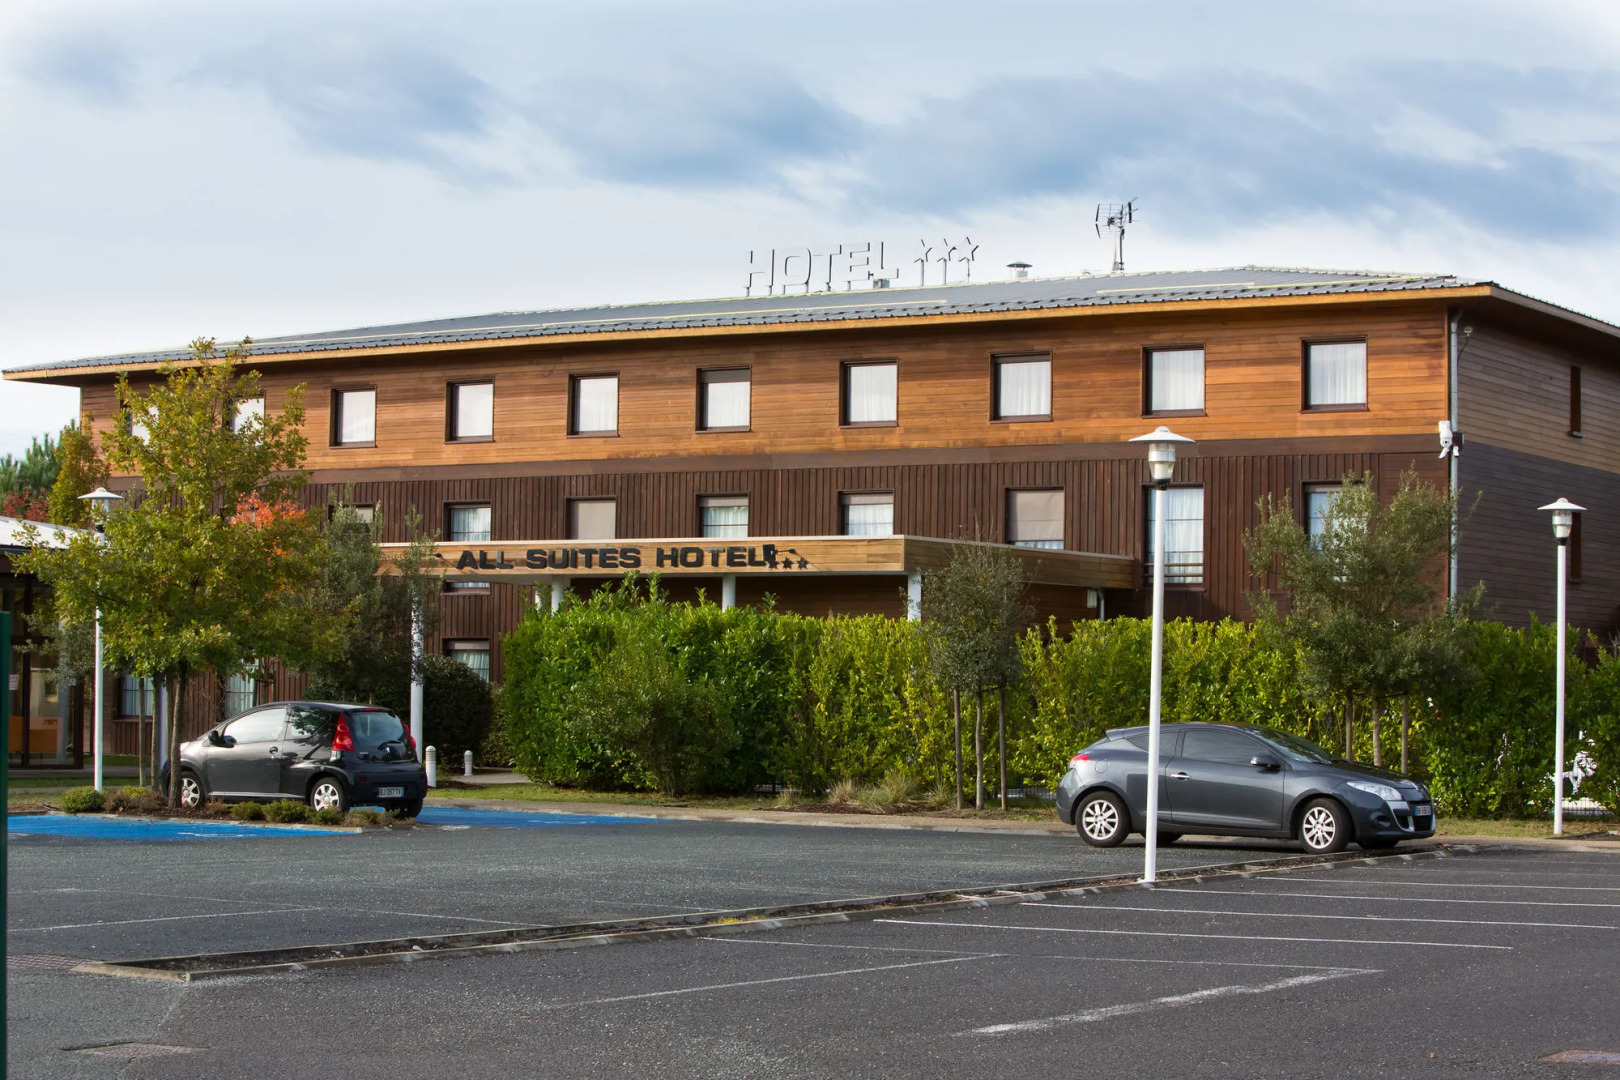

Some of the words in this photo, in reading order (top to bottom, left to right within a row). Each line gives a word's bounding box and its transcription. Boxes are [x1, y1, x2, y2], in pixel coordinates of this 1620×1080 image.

[744, 241, 899, 288] HOTEL
[456, 549, 514, 570] ALL
[526, 547, 642, 569] SUITES
[656, 546, 766, 568] HOTEL
